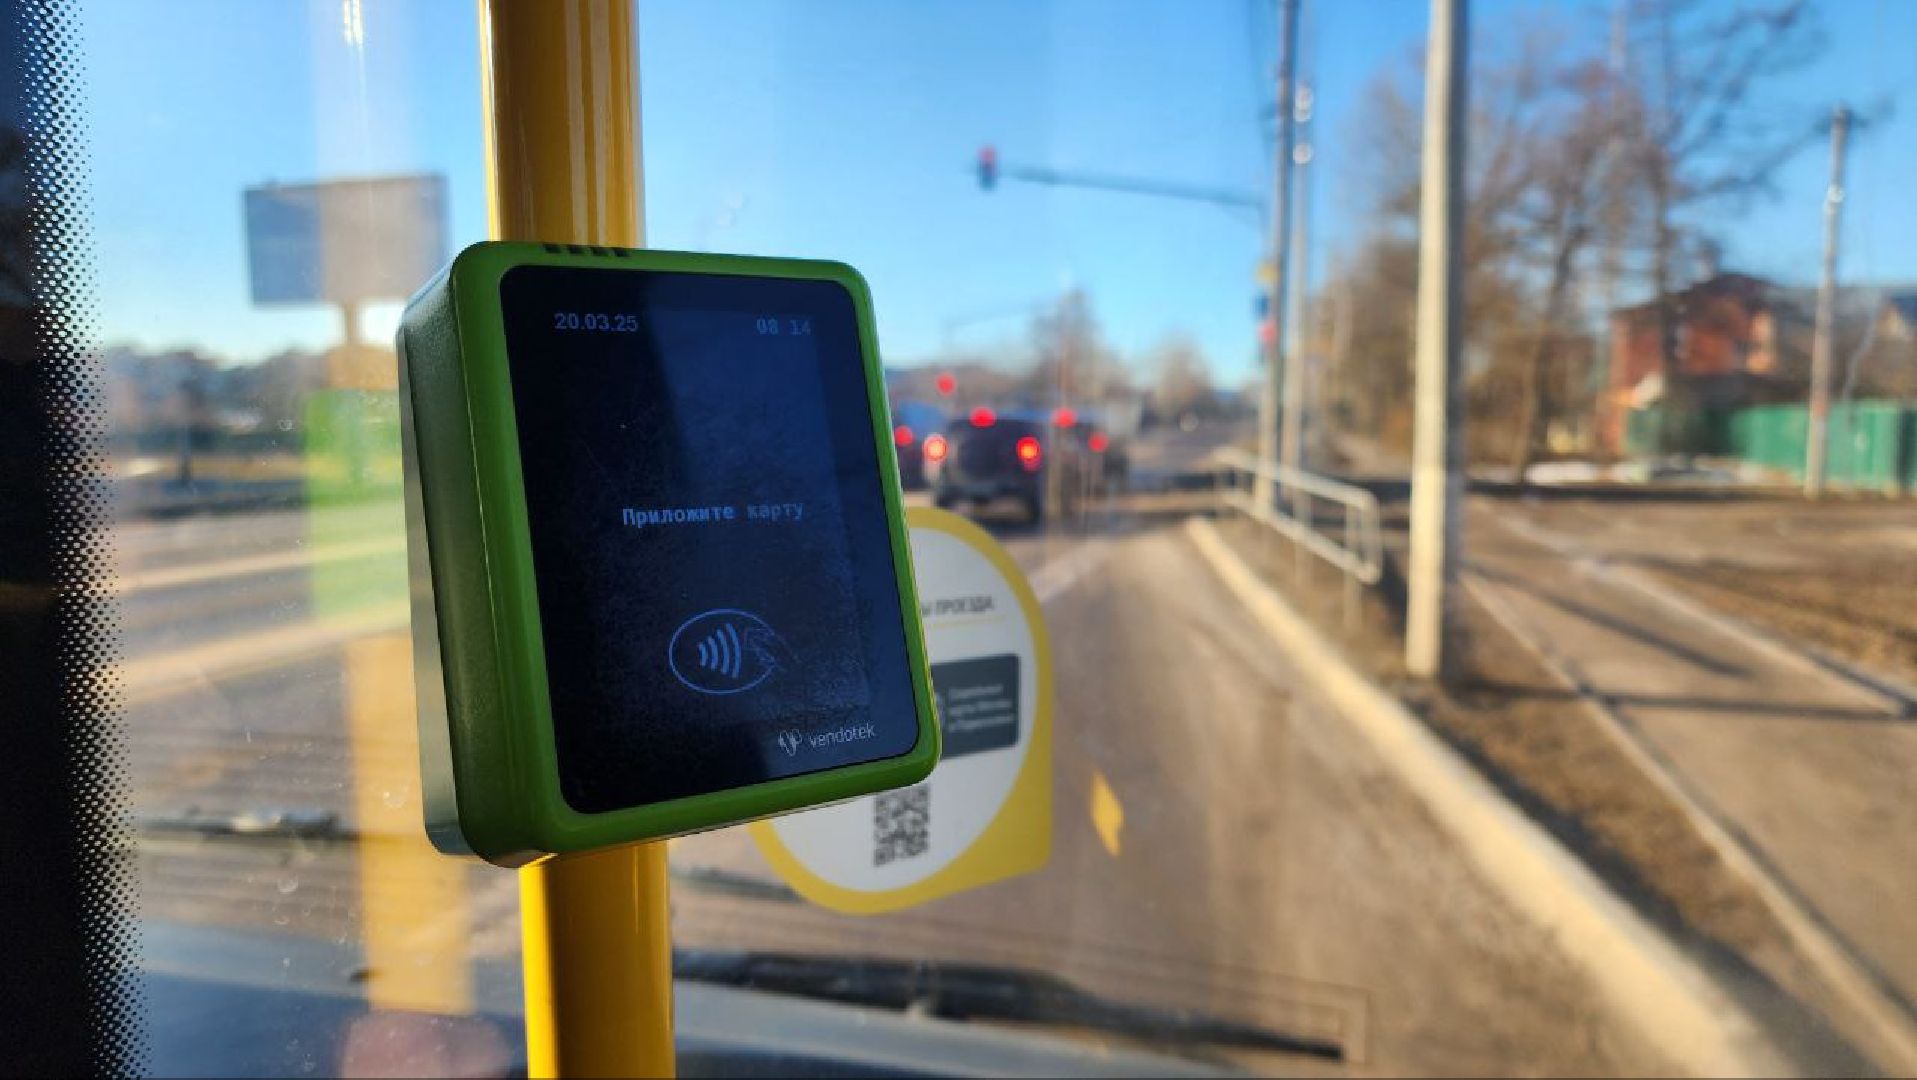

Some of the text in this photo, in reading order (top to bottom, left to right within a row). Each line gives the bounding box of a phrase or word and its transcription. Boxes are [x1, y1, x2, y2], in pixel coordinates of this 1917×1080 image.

[554, 312, 639, 333] 20.03.25
[622, 502, 804, 529] Приложите карту
[808, 722, 876, 748] vendotek
